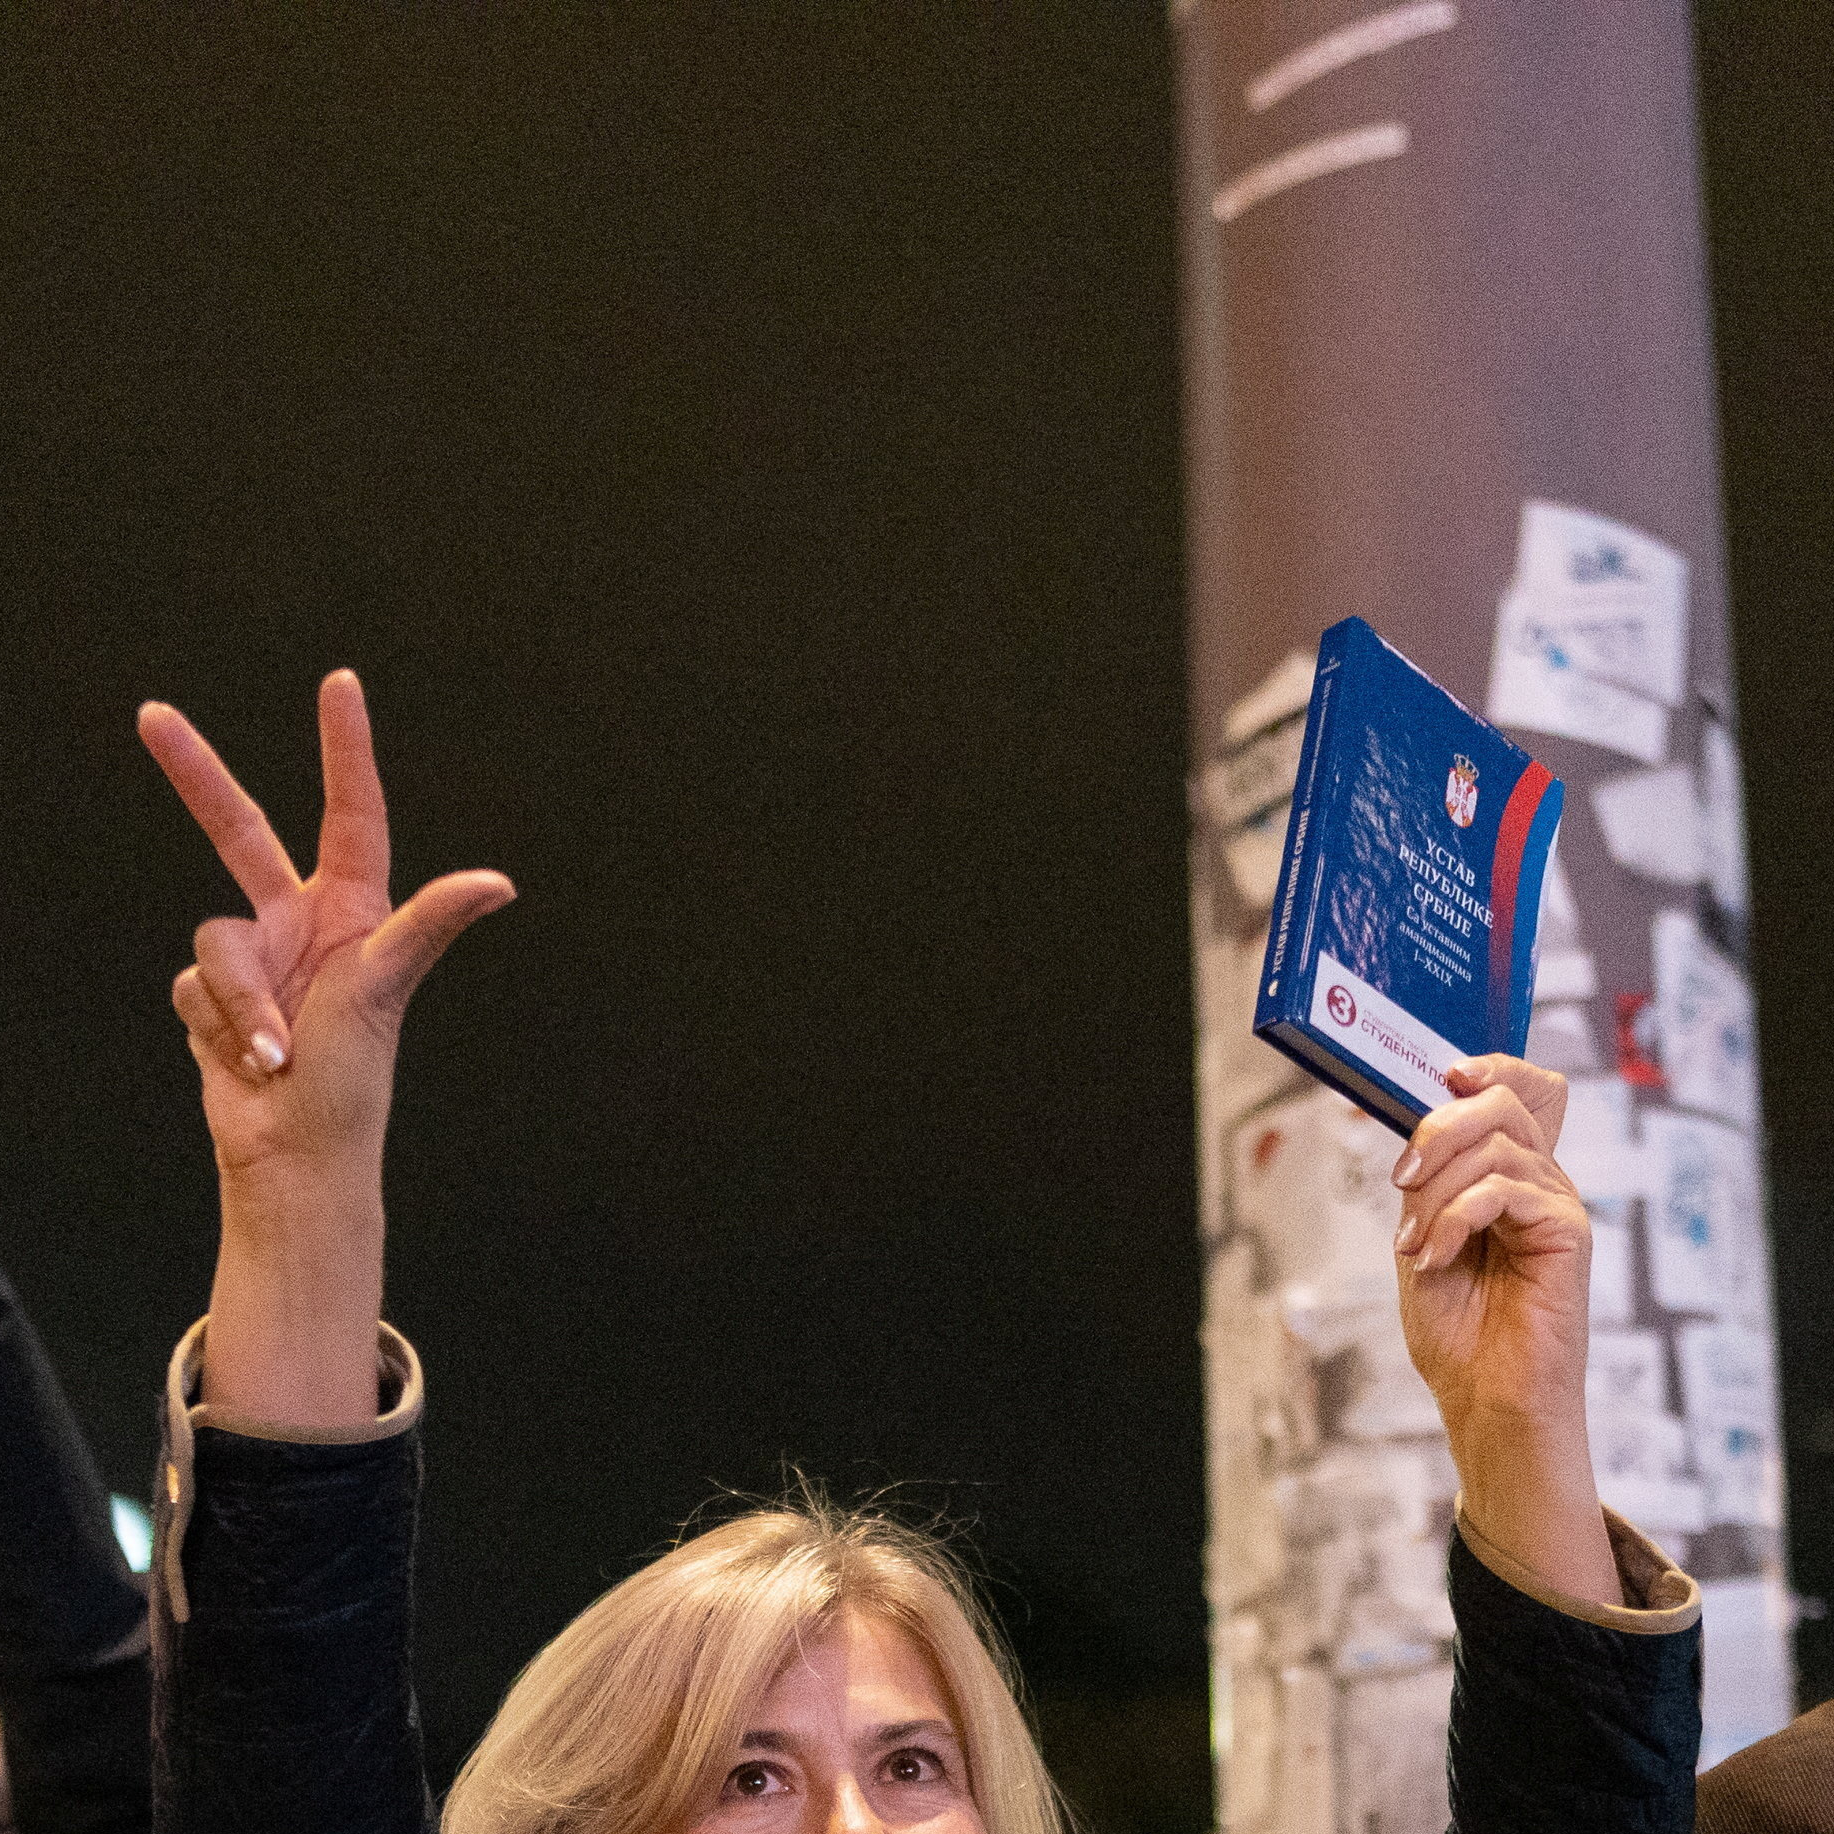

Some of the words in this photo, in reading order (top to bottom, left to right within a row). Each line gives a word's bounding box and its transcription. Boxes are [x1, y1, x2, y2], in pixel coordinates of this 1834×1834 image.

[1399, 844, 1494, 929] РЕПУБЛИКЕ
[1427, 837, 1476, 888] УСТАВ
[1414, 882, 1472, 938] СРБИЈЕ
[1361, 1019, 1426, 1074] СТУДЕНТИ
